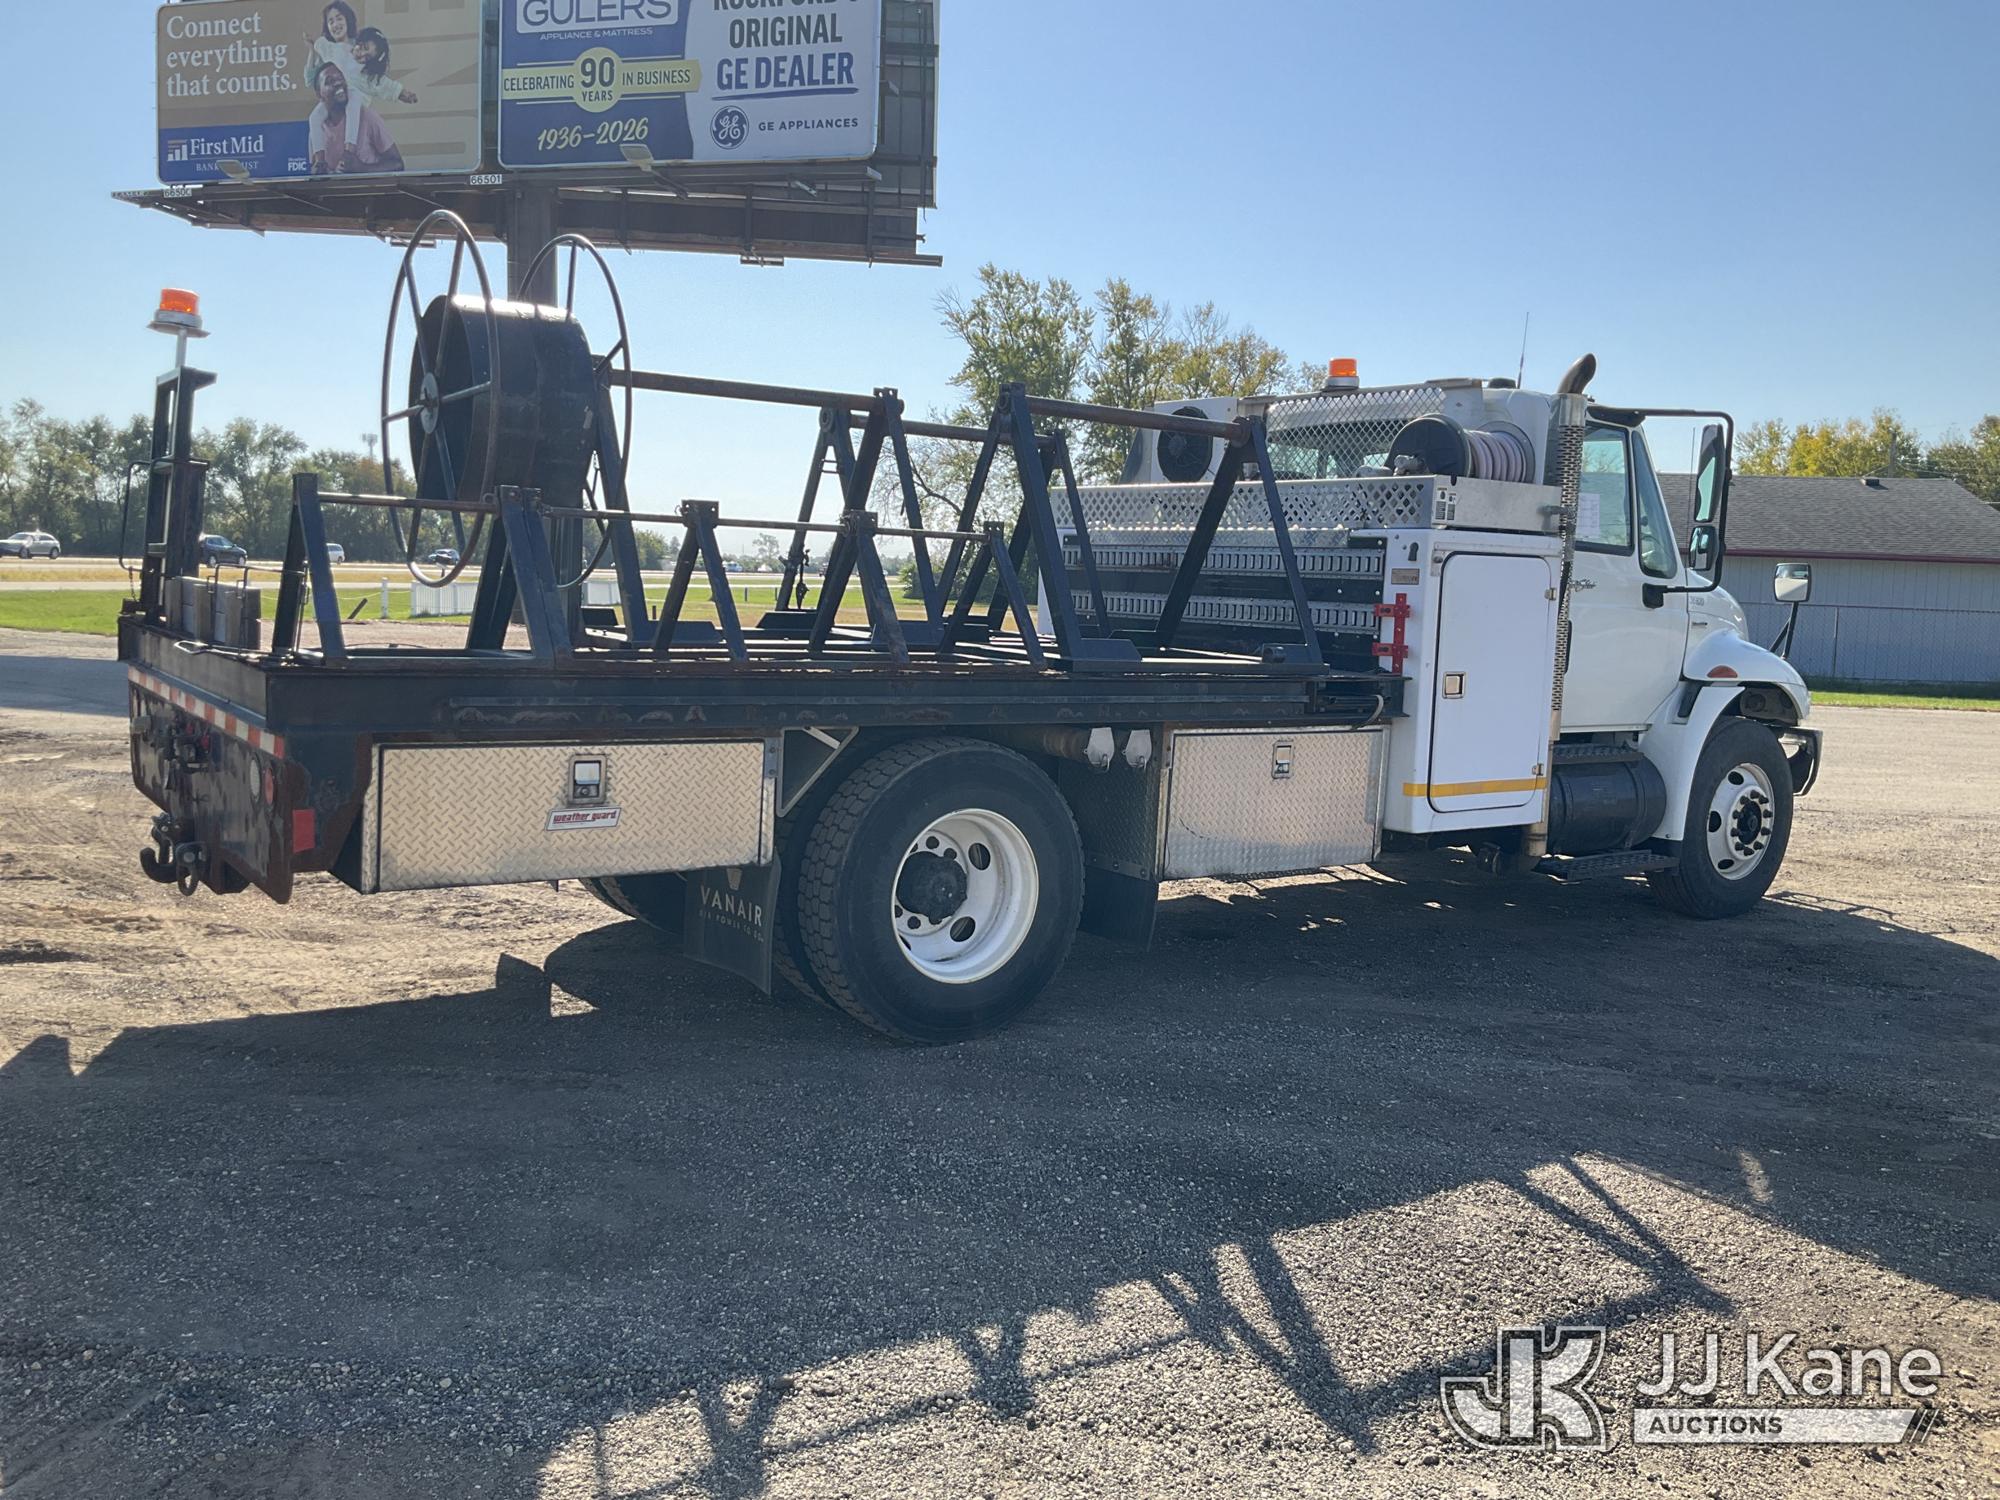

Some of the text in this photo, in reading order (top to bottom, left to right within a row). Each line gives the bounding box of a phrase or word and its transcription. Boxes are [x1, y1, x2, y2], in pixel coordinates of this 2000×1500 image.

[166, 12, 261, 39] Connect
[540, 31, 592, 40] APPLIANCE
[602, 27, 653, 37] MATTRESS
[729, 13, 843, 48] ORIGINAL
[166, 40, 287, 72] everything
[167, 71, 297, 97] that counts.
[503, 56, 691, 92] CELEBRATING 90 IN BUSINESS
[717, 52, 854, 90] GE DEALER
[581, 90, 613, 102] YEARS
[758, 118, 859, 132] GE APPLIANCES
[190, 134, 264, 155] First Mid
[287, 161, 307, 171] FDIC
[470, 174, 501, 185] 66501
[700, 885, 762, 927] VANAIR
